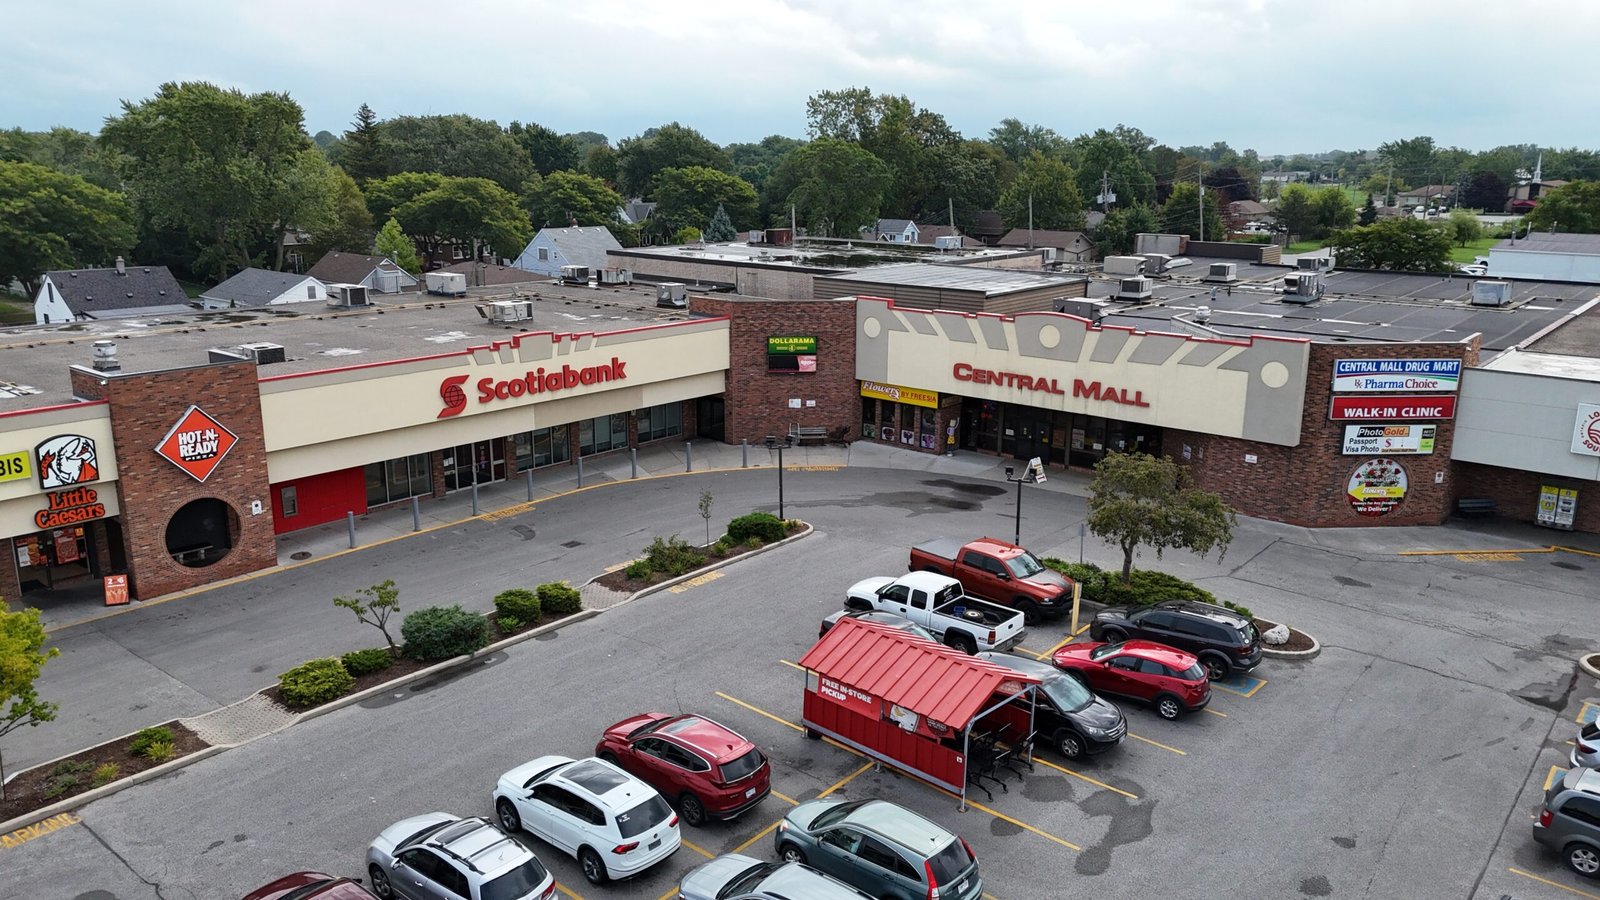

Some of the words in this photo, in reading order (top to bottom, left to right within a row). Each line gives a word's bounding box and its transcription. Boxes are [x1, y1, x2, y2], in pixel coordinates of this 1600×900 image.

[1339, 361, 1377, 372] CENTRAL
[1379, 361, 1403, 372] MALL
[1405, 361, 1430, 372] DRUG
[1433, 361, 1458, 372] MART
[477, 357, 627, 404] Scotiabank
[1344, 408, 1397, 417] WALK-IN
[1401, 407, 1443, 417] CLINIC
[179, 439, 219, 458] READY
[1349, 438, 1378, 446] Passport
[1582, 439, 1600, 453] SOU
[47, 486, 98, 511] Little
[34, 503, 106, 529] Caesars
[821, 678, 839, 690] FREE
[840, 686, 872, 704] IN-STORE
[821, 686, 847, 701] PICKUP
[0, 812, 82, 848] ARKING
